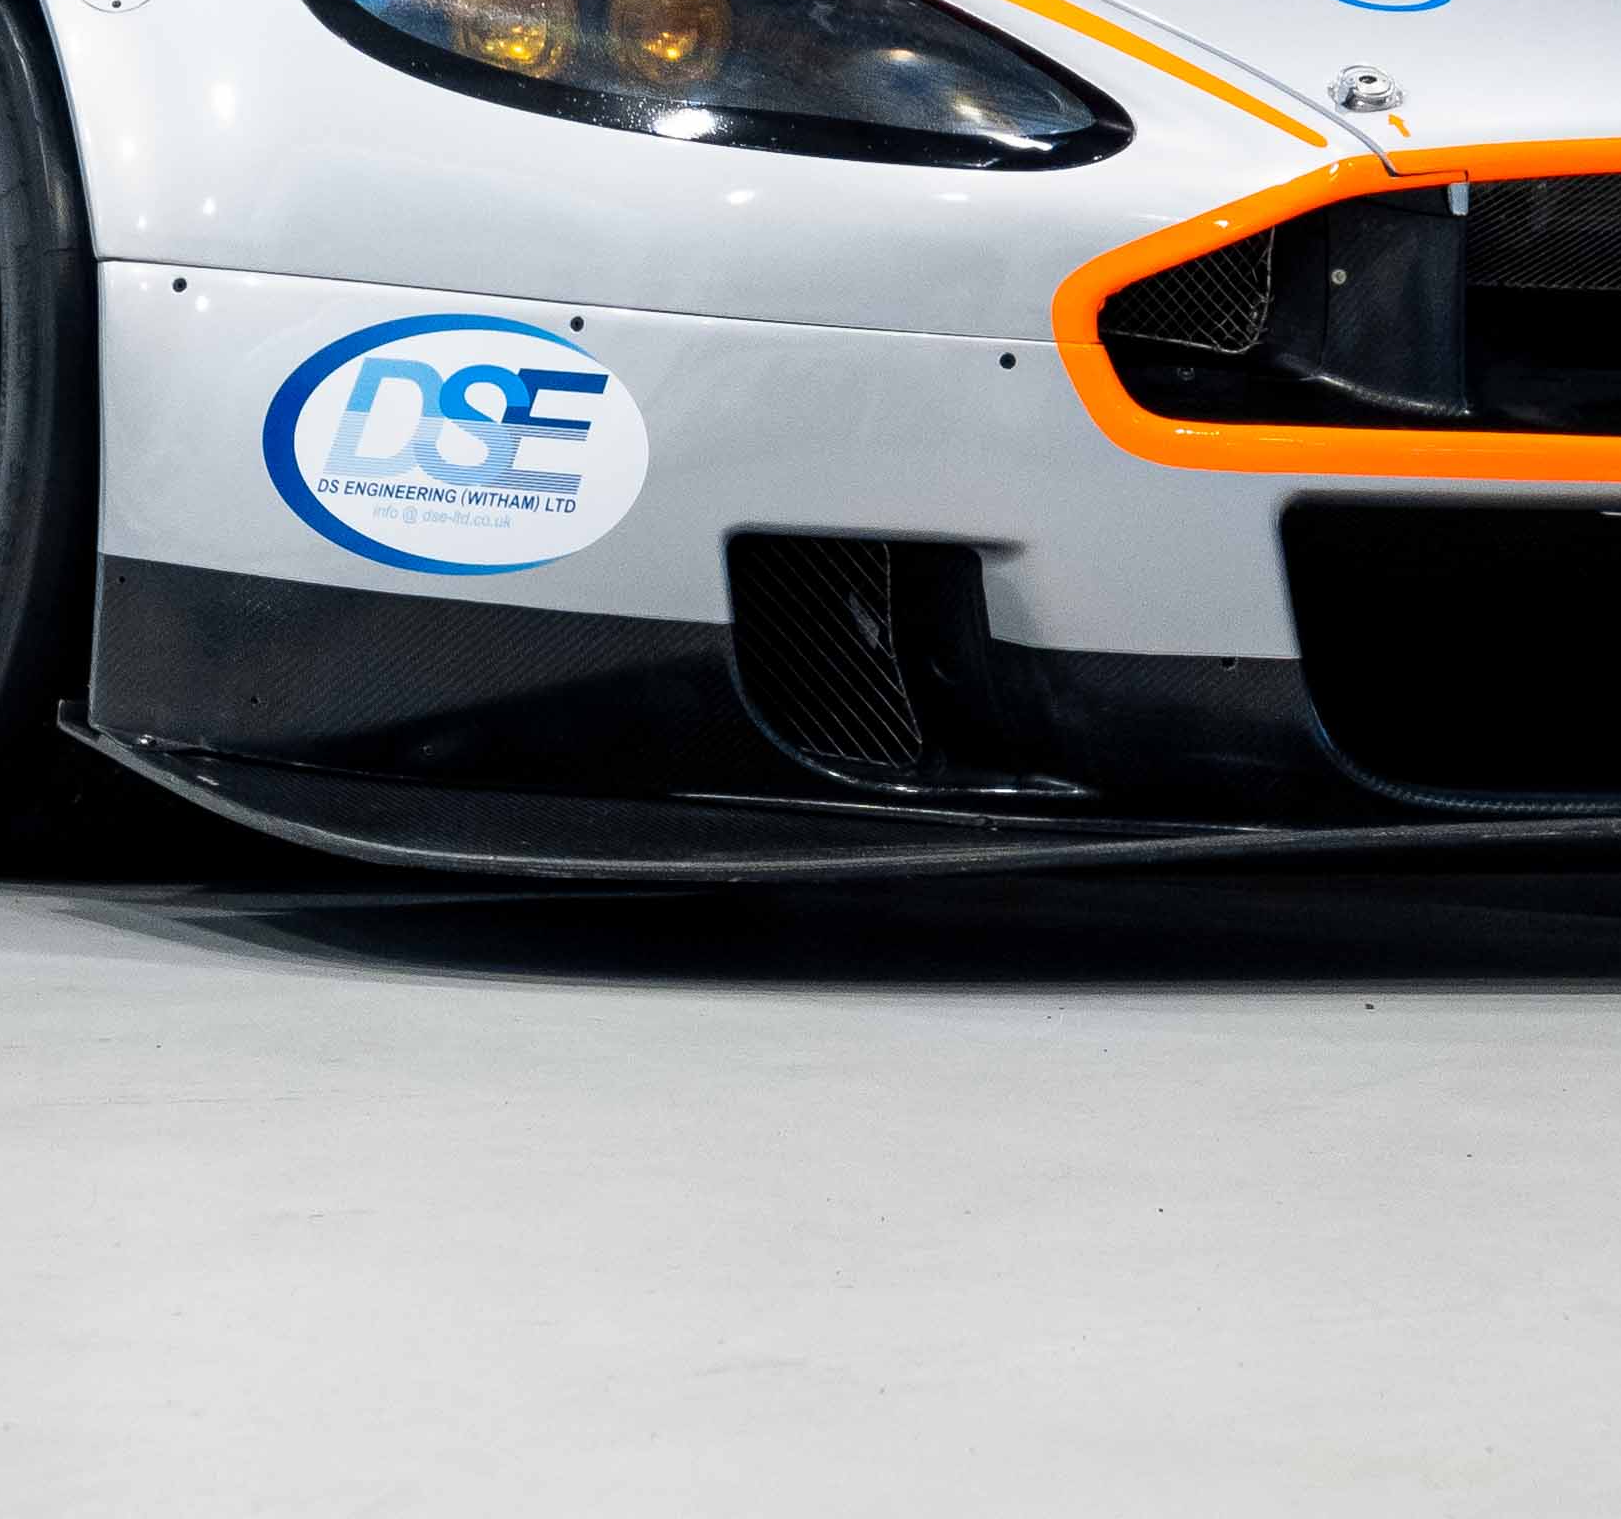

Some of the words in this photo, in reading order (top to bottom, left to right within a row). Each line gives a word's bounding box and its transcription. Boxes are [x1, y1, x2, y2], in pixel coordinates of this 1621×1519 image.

[322, 356, 610, 496] DSE
[316, 478, 340, 494] DS
[343, 480, 457, 504] ENGINEERING
[460, 487, 540, 513] (WITHAM)
[544, 496, 577, 514] LTD
